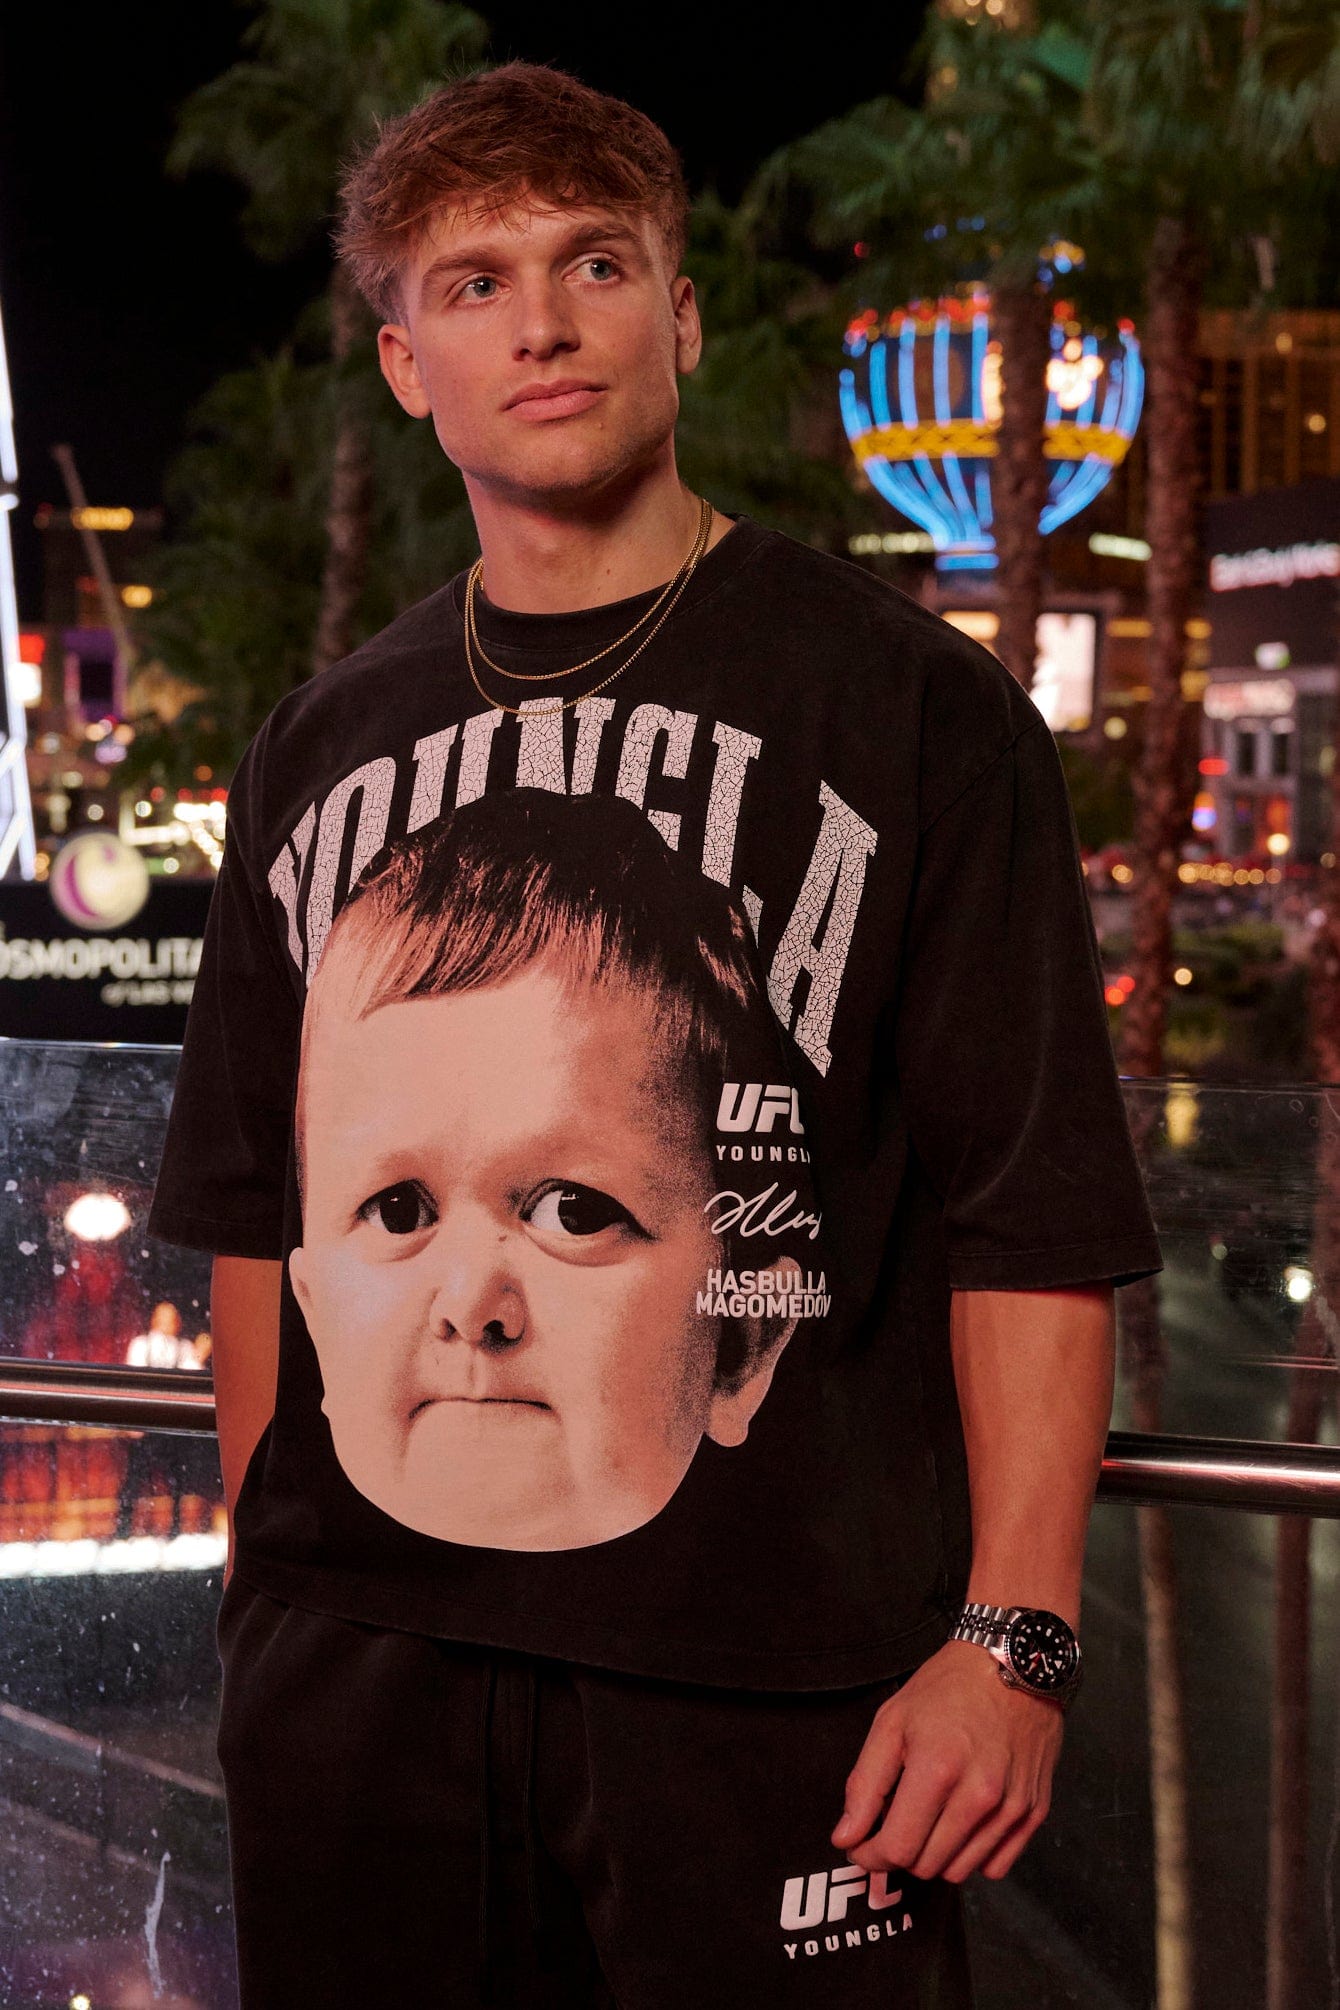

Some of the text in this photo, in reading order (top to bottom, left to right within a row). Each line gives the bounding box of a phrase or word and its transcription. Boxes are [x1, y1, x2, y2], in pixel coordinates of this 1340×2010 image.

[706, 1268, 827, 1295] HASBULLA
[696, 1290, 832, 1319] MAGOMEDOV
[783, 1913, 913, 1959] YOUNGLA
